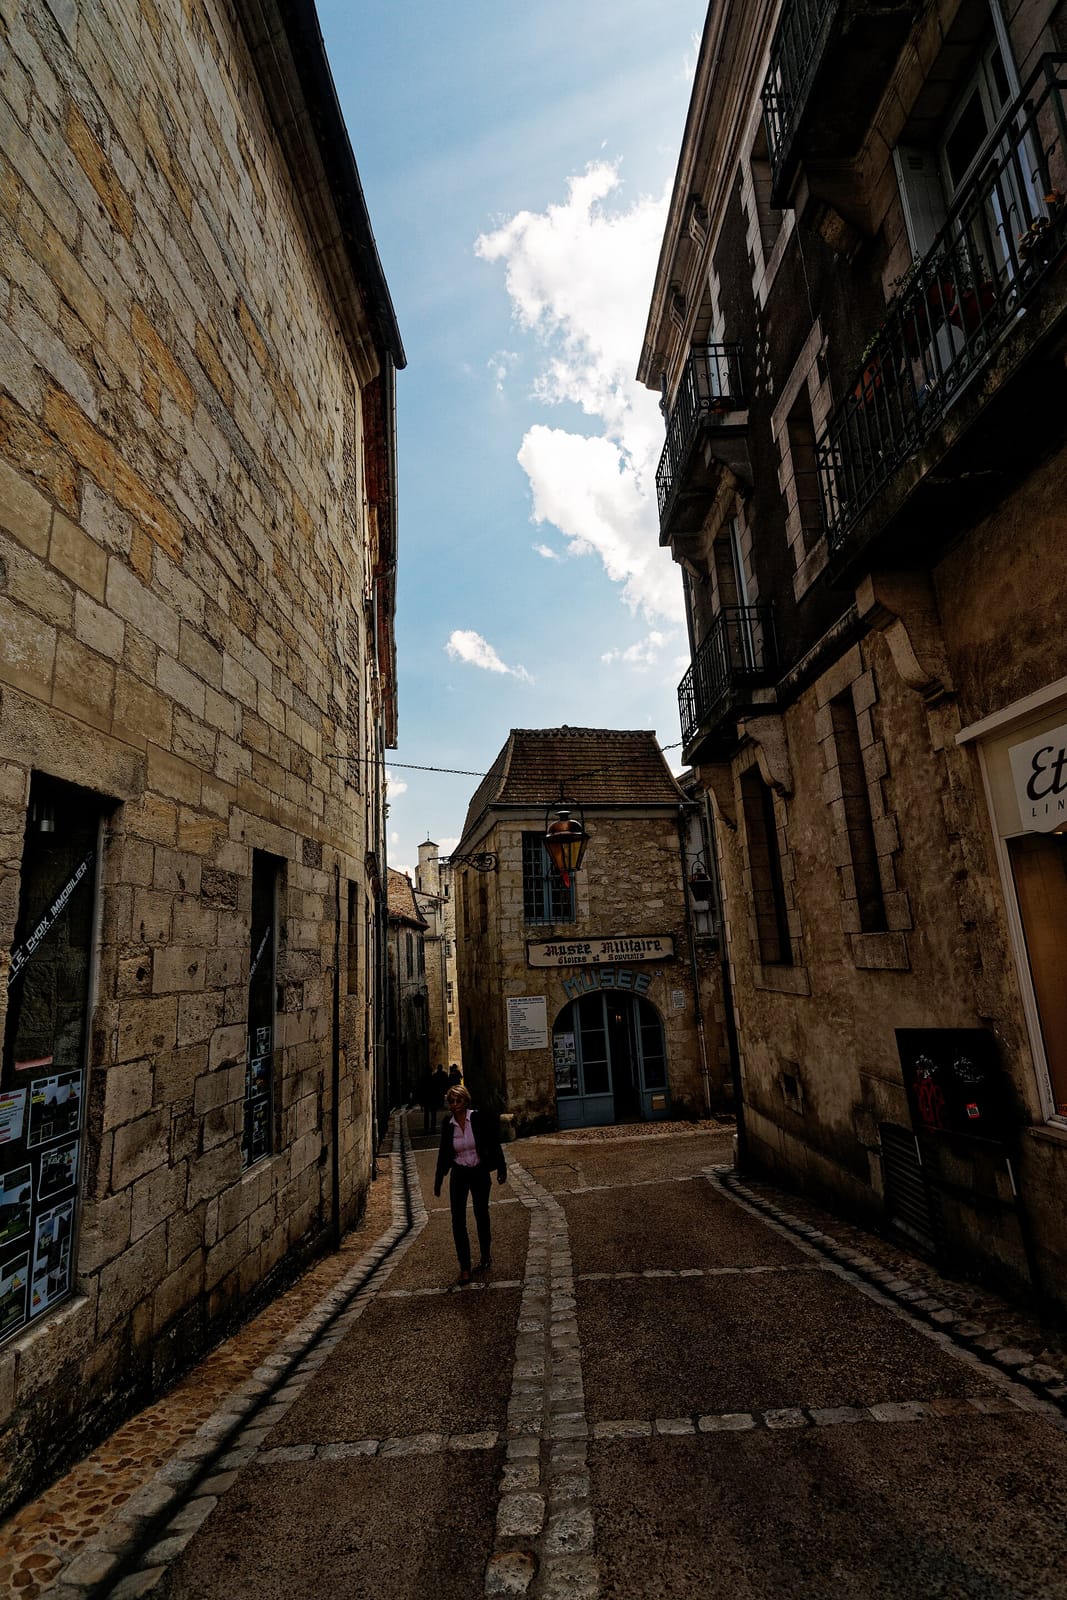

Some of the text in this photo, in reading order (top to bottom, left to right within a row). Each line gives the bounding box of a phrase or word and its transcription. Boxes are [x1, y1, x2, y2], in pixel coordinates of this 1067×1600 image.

[11, 951, 25, 972] LE
[25, 915, 50, 951] CHOIX
[50, 861, 88, 916] IMMOBILIER
[600, 939, 663, 954] Militaire
[562, 968, 652, 999] MUSEE
